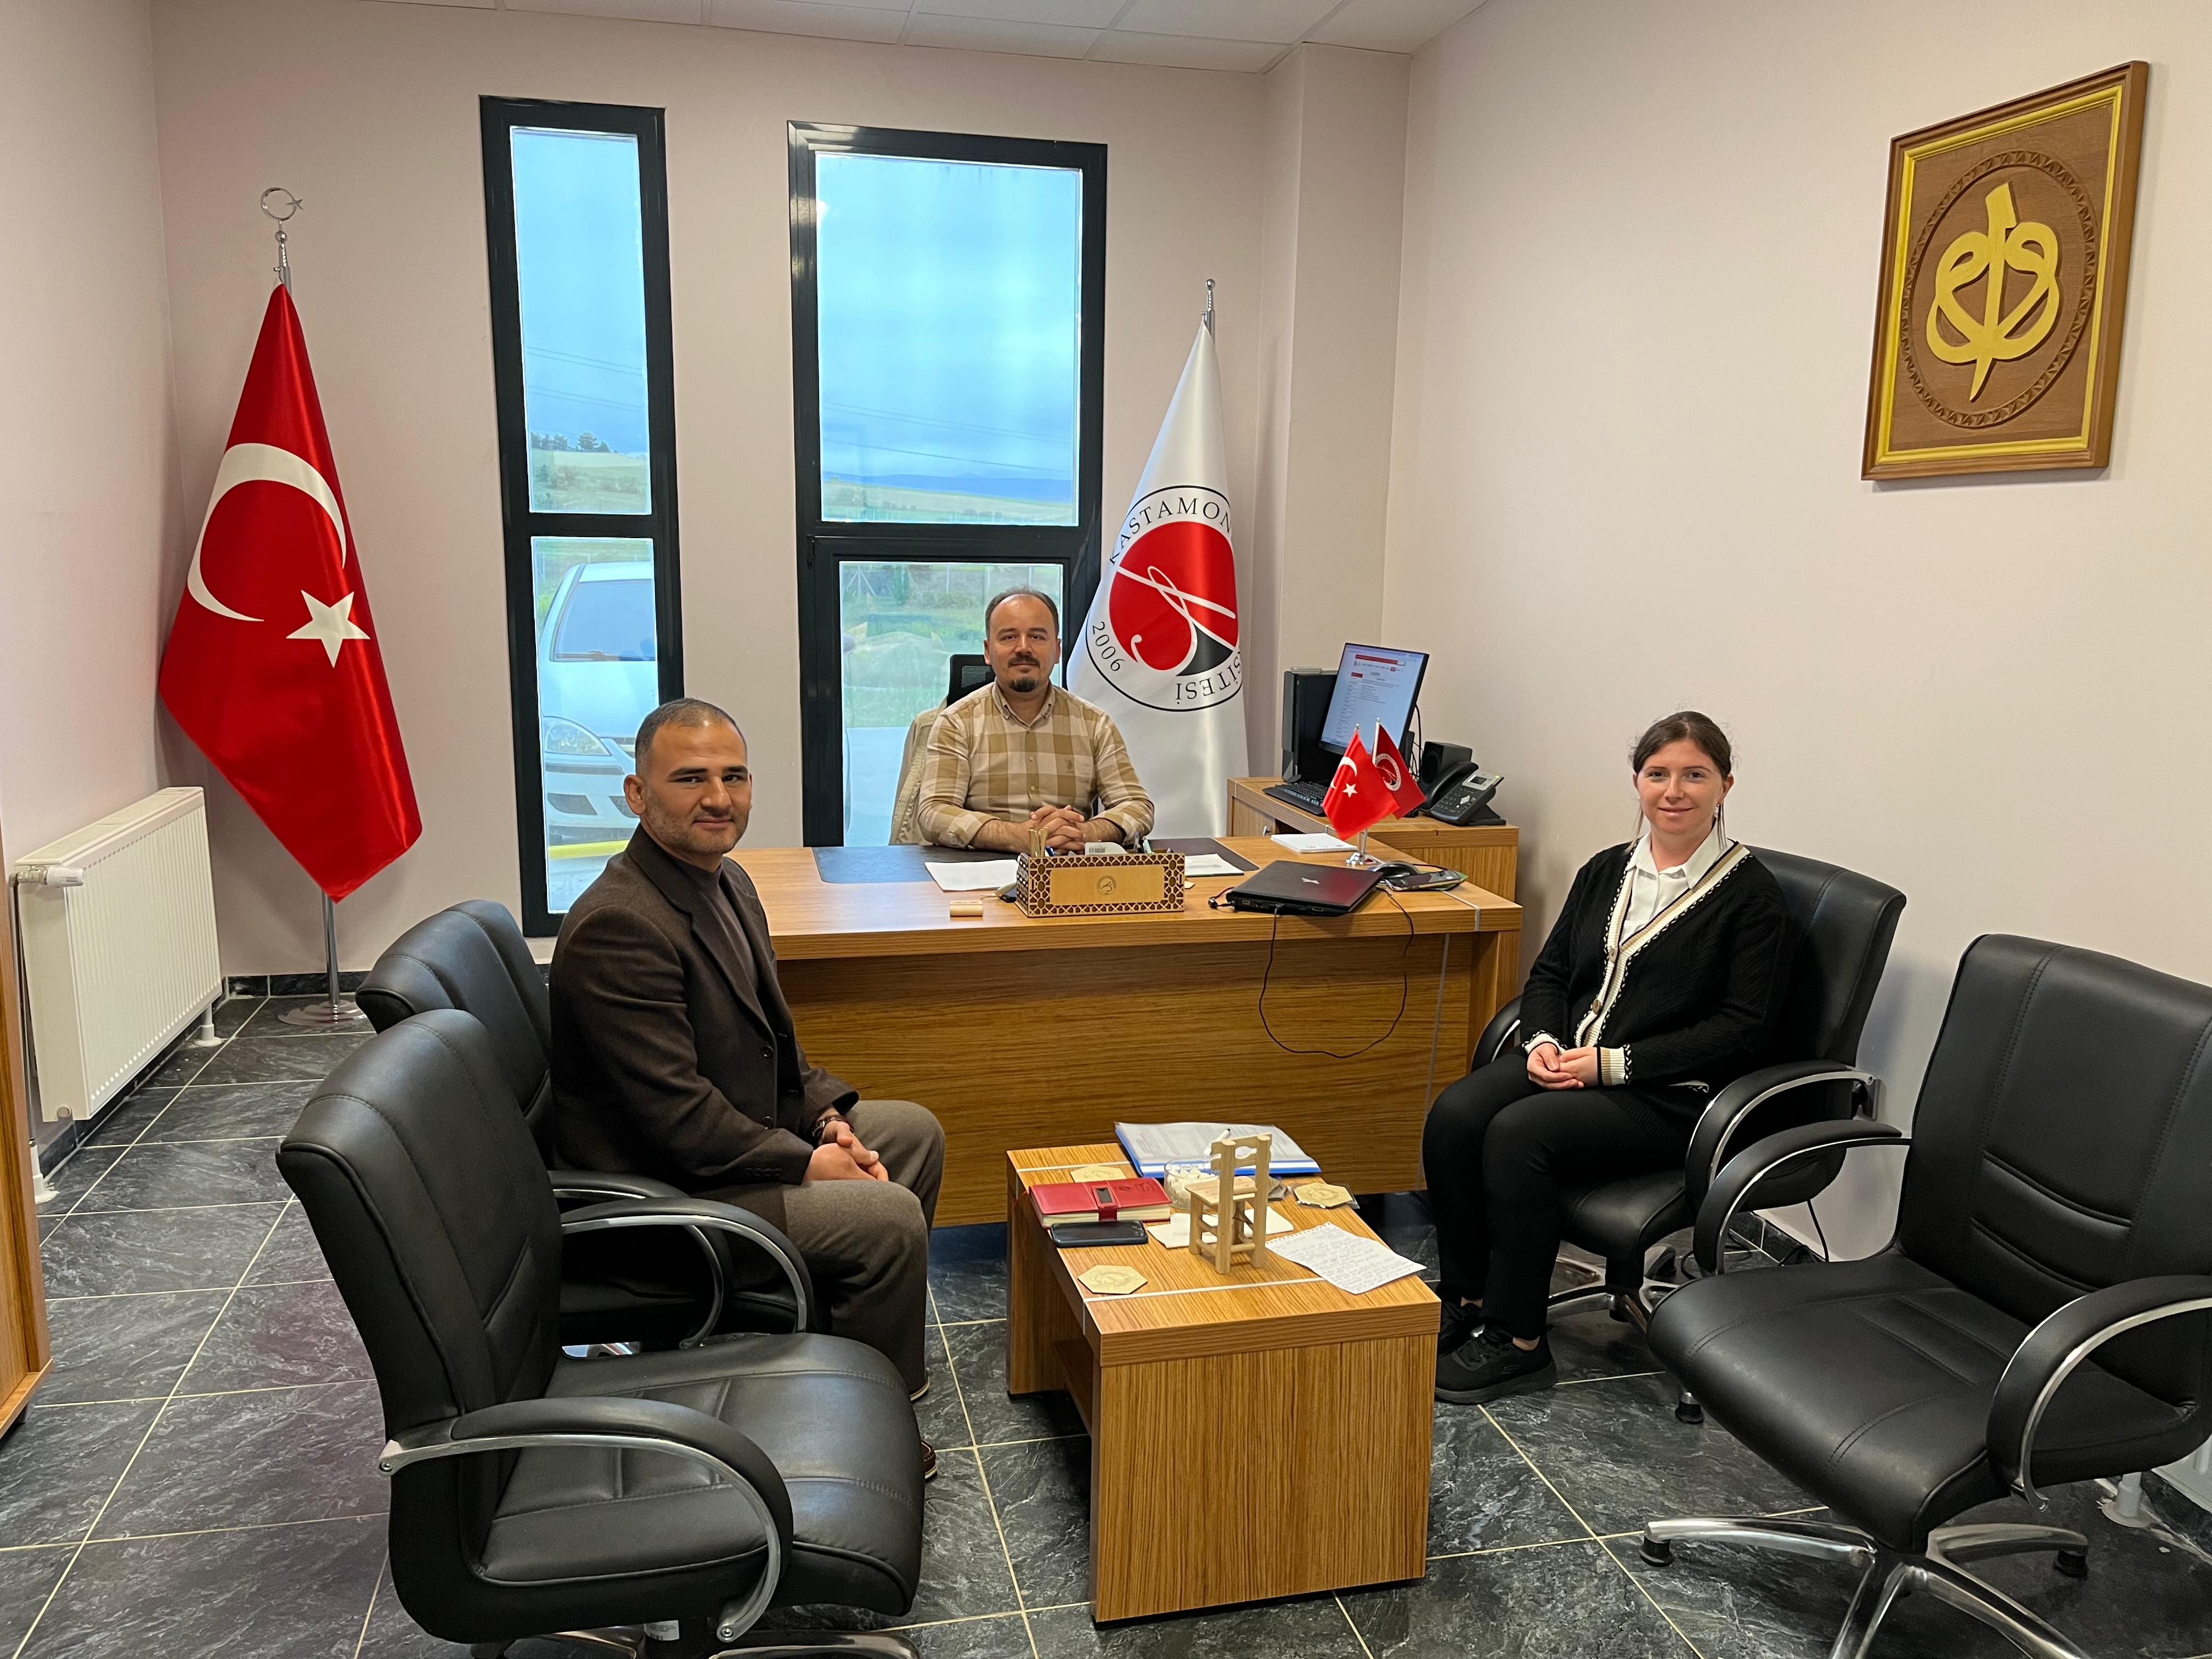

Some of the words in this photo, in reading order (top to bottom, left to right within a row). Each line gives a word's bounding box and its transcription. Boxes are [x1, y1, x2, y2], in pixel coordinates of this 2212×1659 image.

[1109, 497, 1231, 566] KASTAMON
[1092, 621, 1125, 672] 2006
[1175, 651, 1240, 704] SİTESİ
